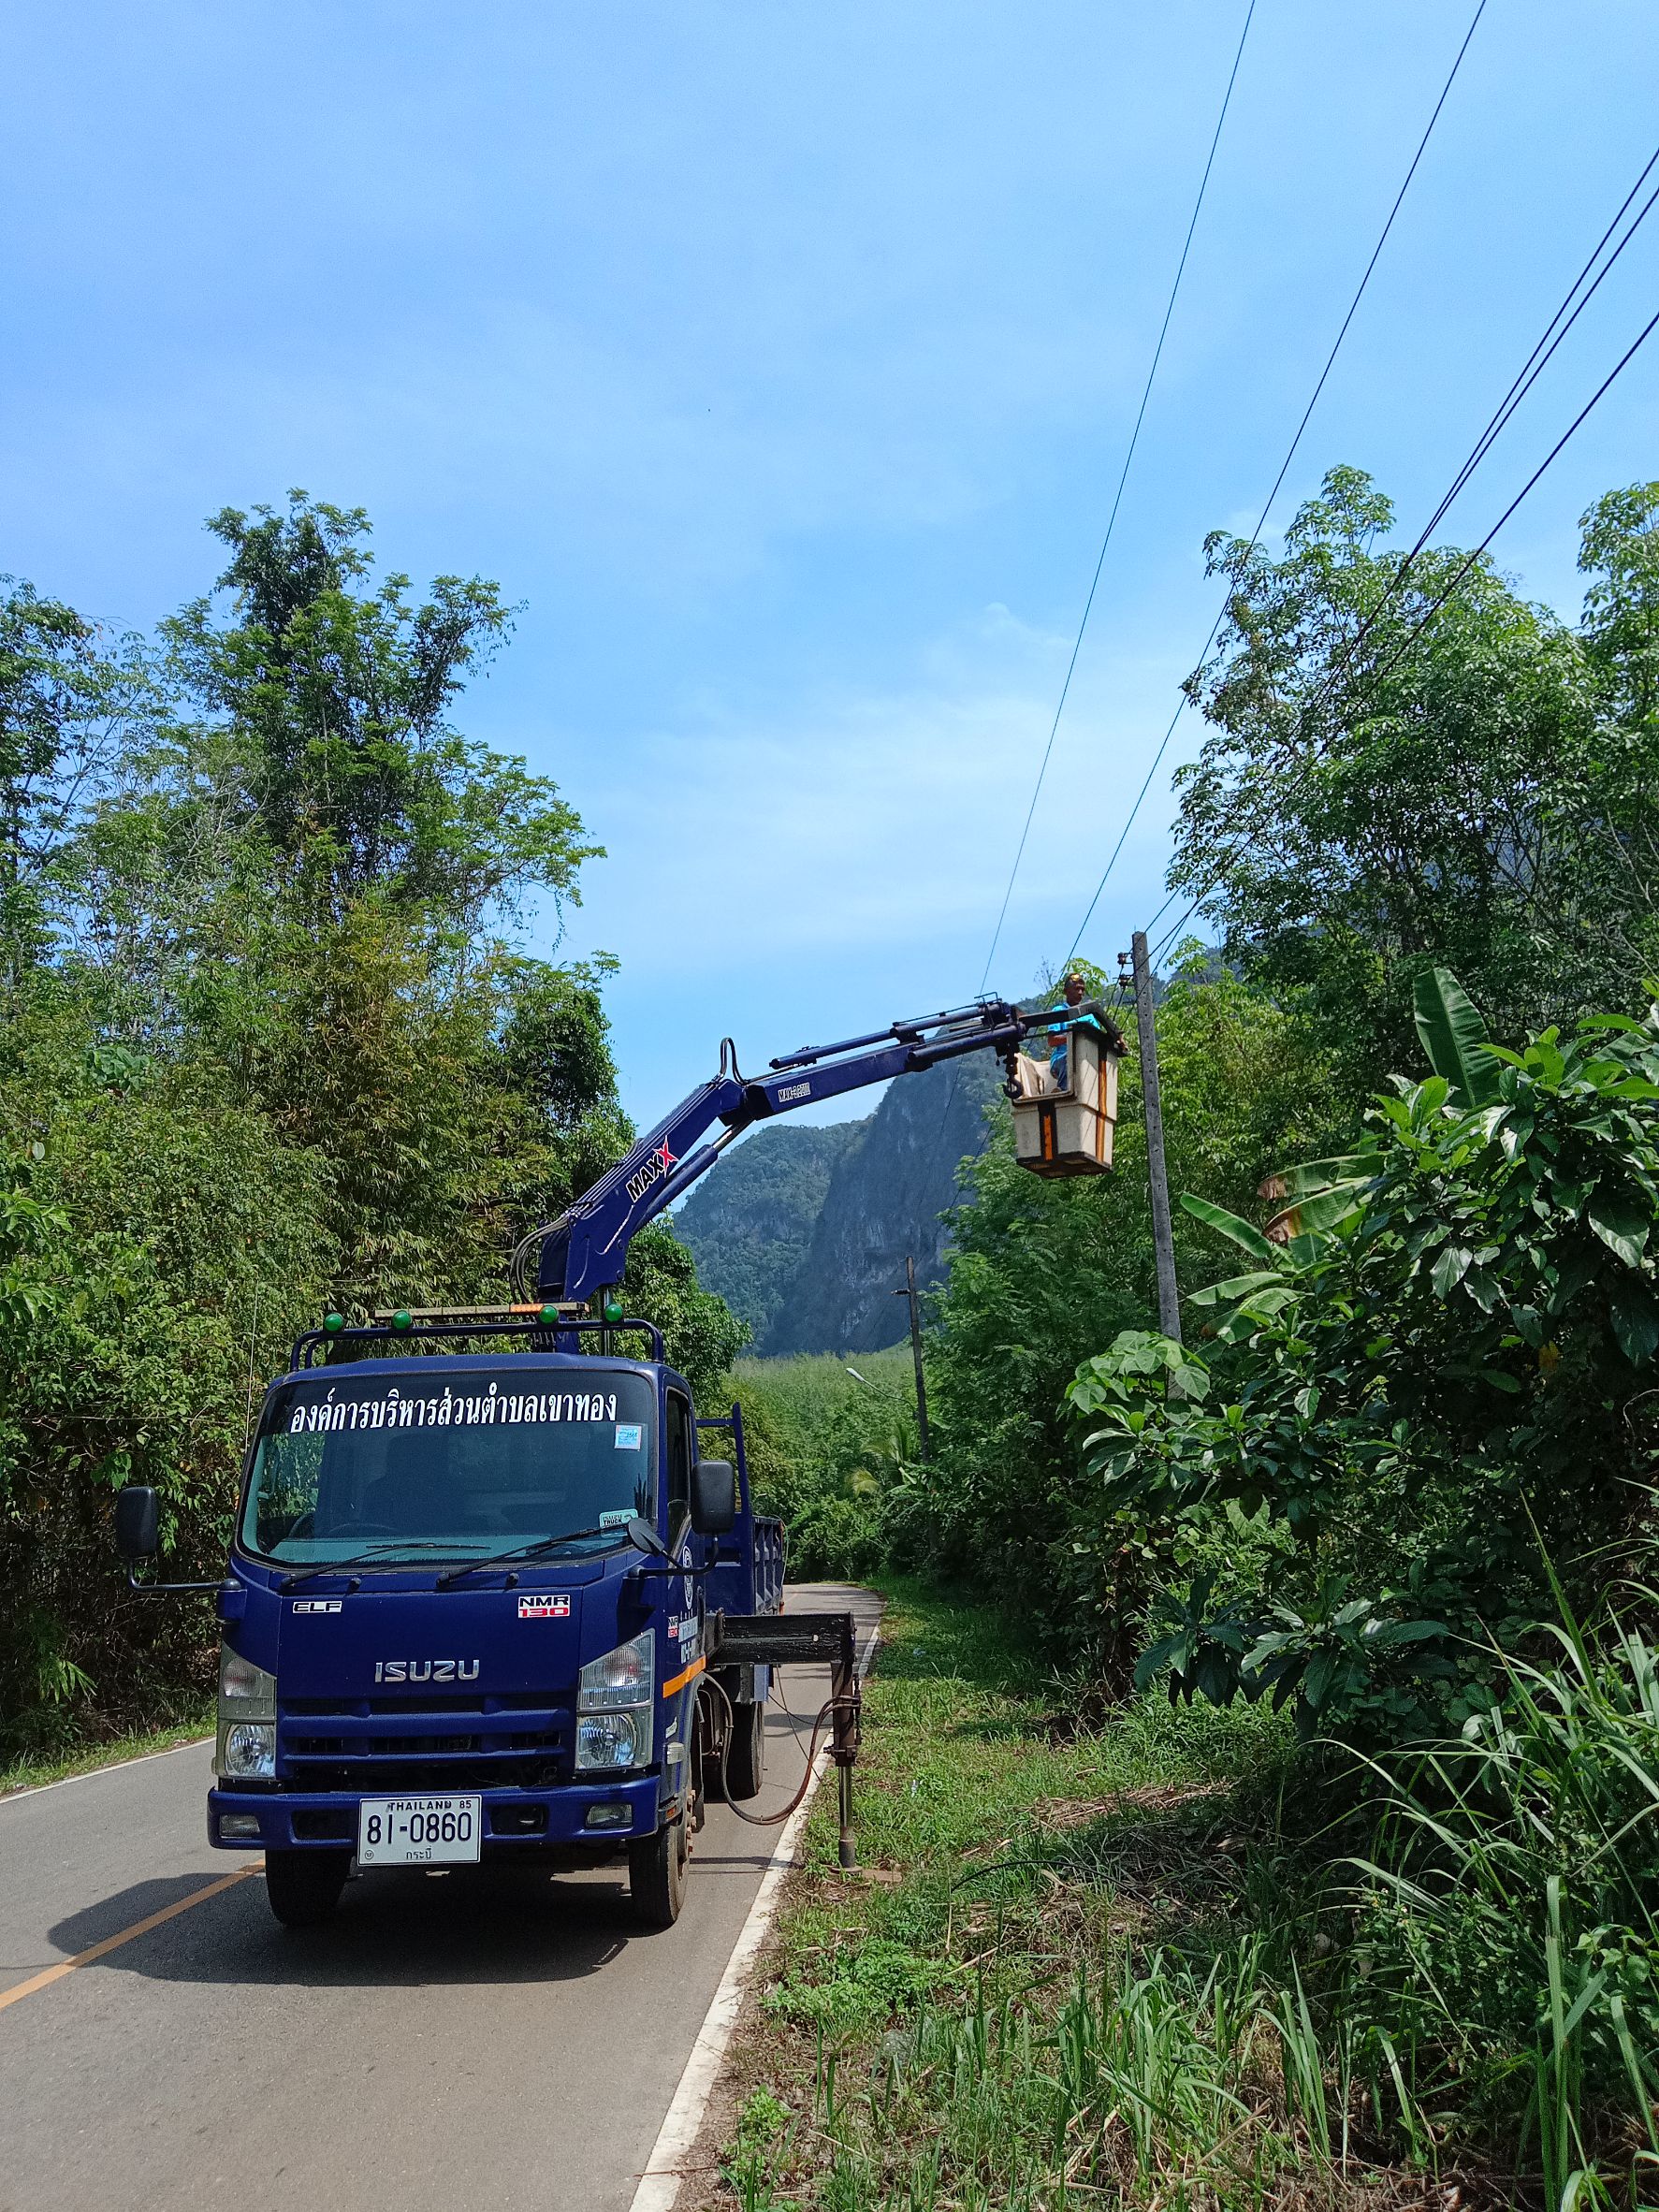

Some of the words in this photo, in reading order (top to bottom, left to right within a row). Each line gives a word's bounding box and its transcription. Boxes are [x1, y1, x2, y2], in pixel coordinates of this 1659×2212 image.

[289, 1382, 617, 1433] องค์การบริหารส่วนตำบลเขาทอง
[294, 1602, 342, 1612] ELF
[519, 1595, 569, 1607] NMR
[519, 1608, 569, 1617] 130
[375, 1659, 480, 1682] ISUZU
[389, 1800, 452, 1812] THAILAND
[459, 1799, 472, 1809] 85
[367, 1812, 472, 1844] 81-0860
[406, 1845, 432, 1859] กระบี่
